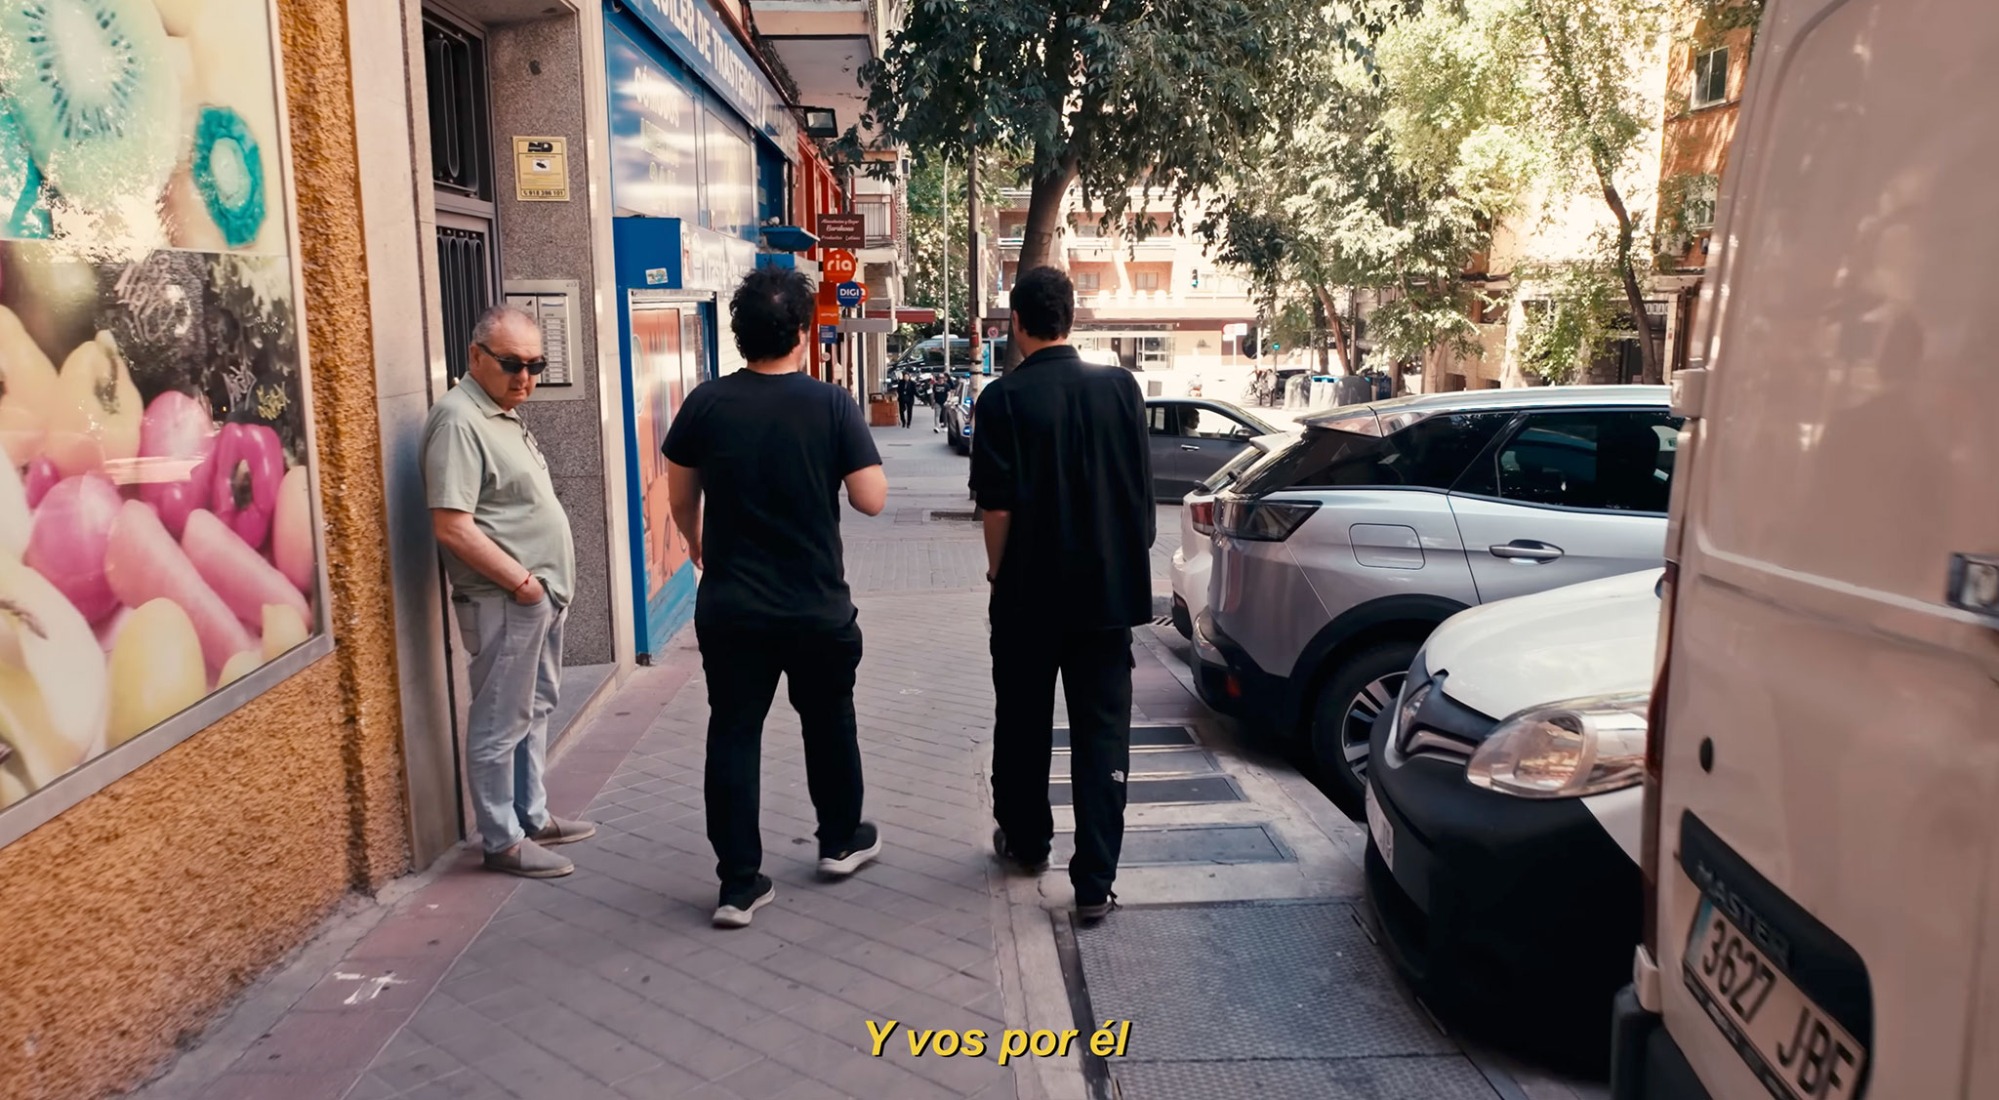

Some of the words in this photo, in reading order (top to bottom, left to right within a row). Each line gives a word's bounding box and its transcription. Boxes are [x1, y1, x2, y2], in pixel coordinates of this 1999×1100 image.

[696, 8, 712, 64] DE
[827, 253, 852, 271] ria
[839, 288, 860, 296] DIGI
[1702, 917, 1777, 1025] 3627
